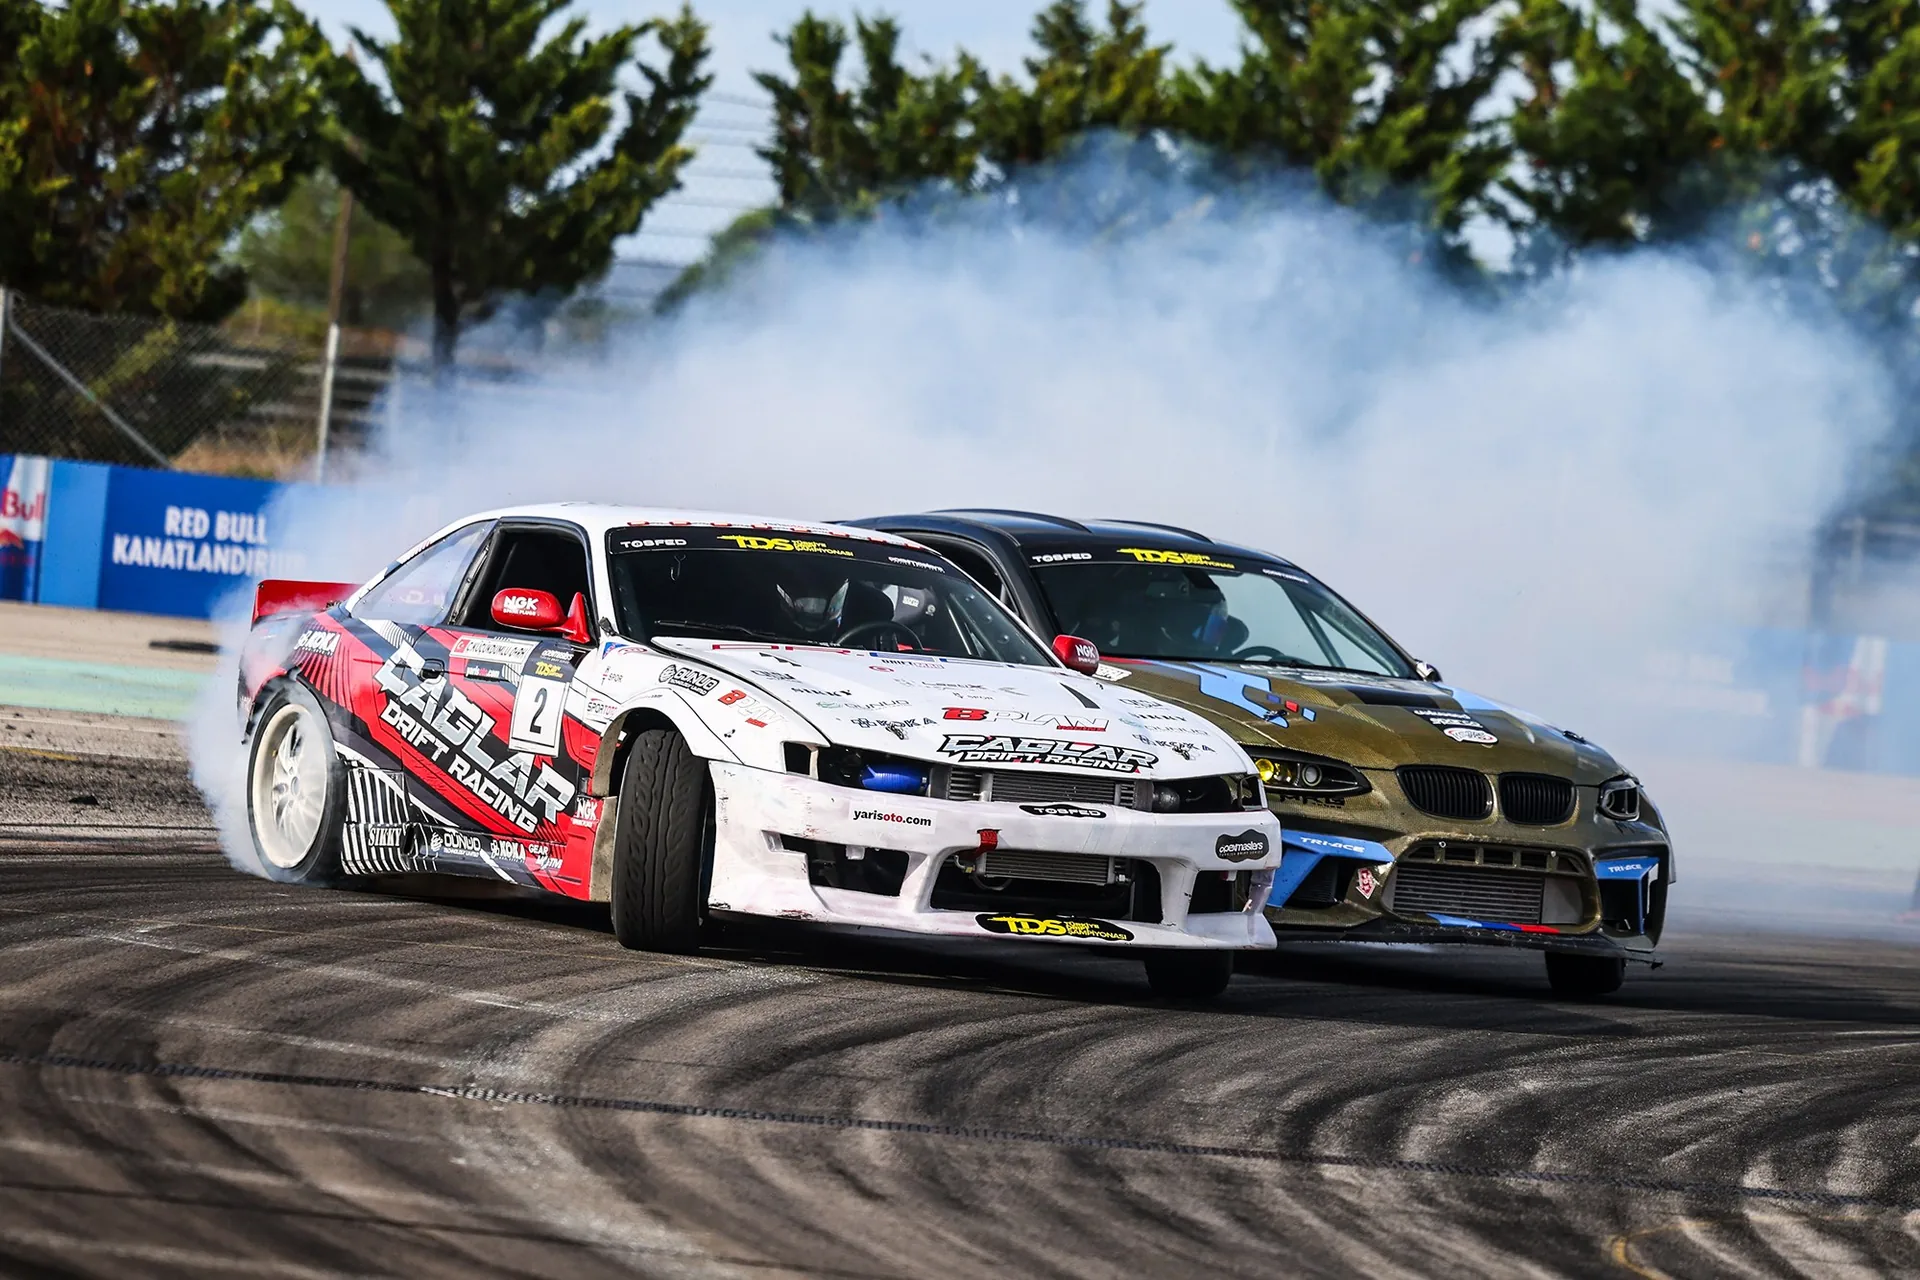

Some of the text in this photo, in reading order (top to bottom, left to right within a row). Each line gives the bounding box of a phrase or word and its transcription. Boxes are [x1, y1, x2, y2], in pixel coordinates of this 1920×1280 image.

[165, 506, 267, 545] RED BULL
[620, 539, 687, 548] TOSFED
[717, 535, 795, 551] TDS
[1032, 552, 1092, 563] TOSFED
[1117, 548, 1185, 565] TDS
[504, 596, 539, 610] NGK
[305, 630, 341, 652] KOKA
[1075, 644, 1096, 658] NGK
[529, 688, 548, 734] 2
[942, 706, 1110, 729] BPLAN
[379, 700, 538, 833] DRIFT RACING
[965, 751, 1136, 773] DRIFT RACING
[577, 797, 598, 821] NGK
[1033, 807, 1101, 816] TOSFED
[853, 810, 931, 826] yarisoto.com
[369, 827, 401, 847] SIKKY
[1300, 837, 1366, 853] TRI-ACE
[499, 840, 526, 860] KOKA
[528, 843, 549, 855] GEAR
[1608, 864, 1643, 873] TRI-ACE
[987, 916, 1067, 935] TDS
